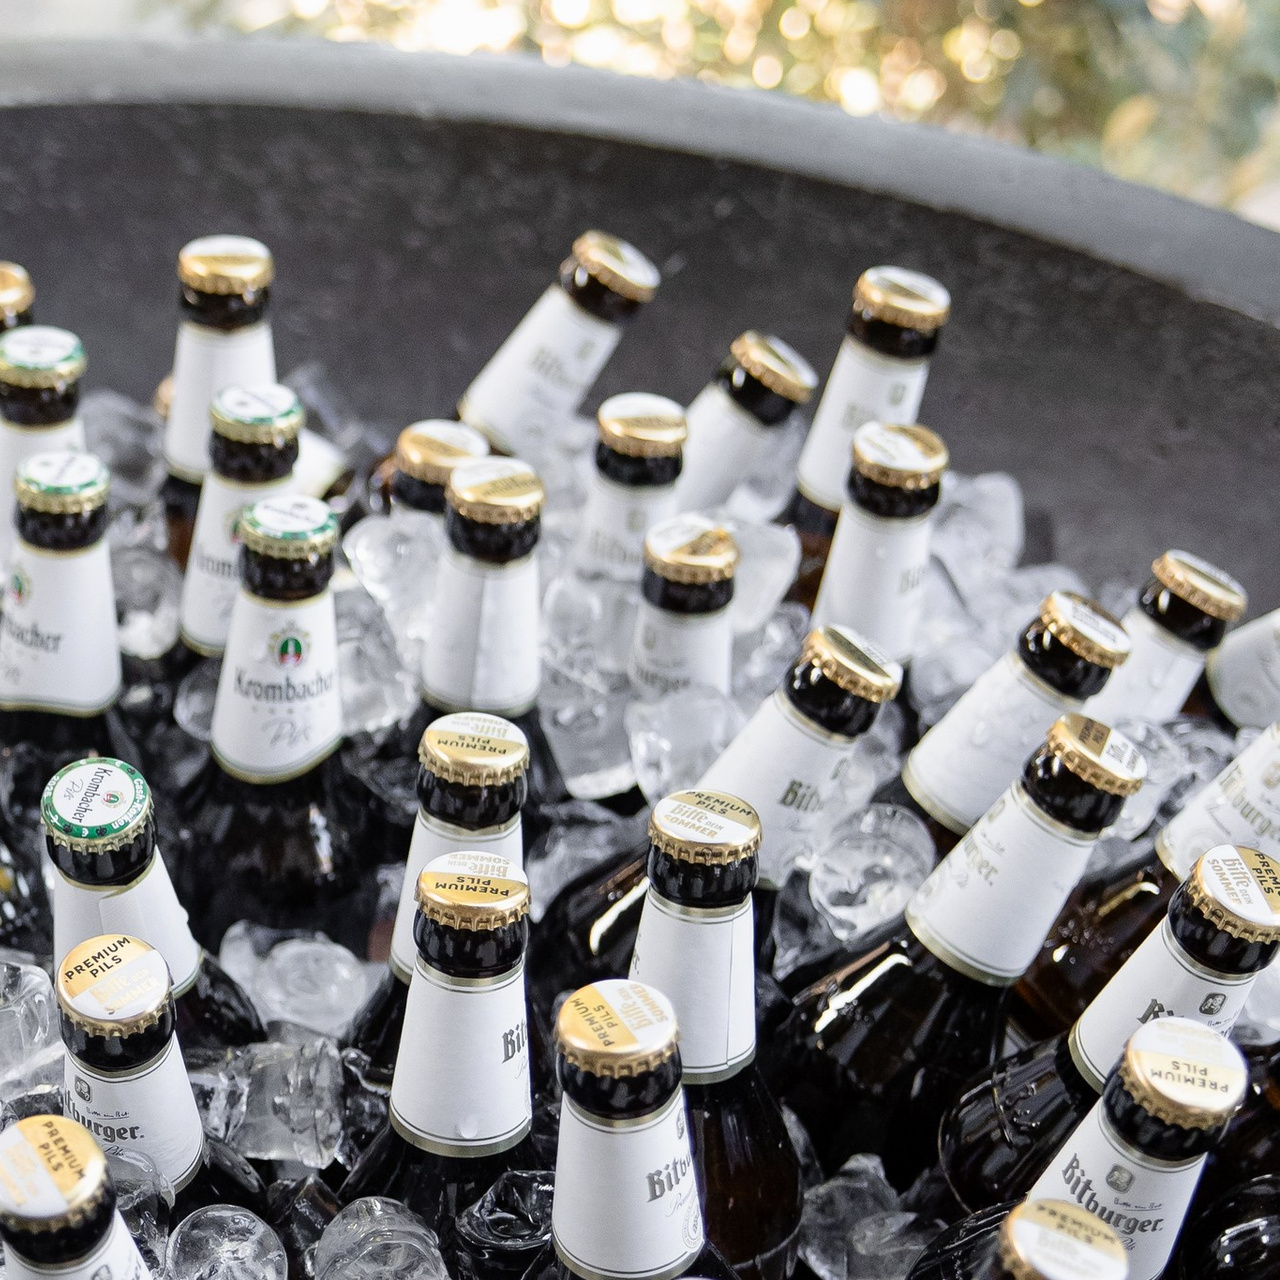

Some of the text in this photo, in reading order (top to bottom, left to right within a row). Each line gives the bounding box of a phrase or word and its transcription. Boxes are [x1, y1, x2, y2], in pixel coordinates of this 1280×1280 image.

[438, 738, 507, 755] PREMIUM
[458, 735, 491, 745] PILS
[63, 778, 84, 801] Pils
[71, 766, 114, 824] Krombacher
[110, 778, 146, 830] Cash-Korken
[686, 791, 752, 817] PREMIUM
[696, 800, 729, 816] PILS
[662, 814, 718, 839] SOMMER
[704, 820, 724, 831] DEIN
[434, 882, 510, 898] PREMIUM
[456, 876, 492, 887] PILS
[1207, 858, 1243, 906] SOMMER
[1252, 867, 1274, 896] PILS
[1239, 888, 1254, 906] DEIN
[65, 936, 131, 981] PREMIUM
[89, 954, 123, 979] PILS
[570, 997, 616, 1047] PREMIUM
[593, 1004, 619, 1029] PILS
[1151, 1068, 1229, 1093] PREMIUM
[1171, 1060, 1208, 1076] PILS
[38, 1141, 64, 1173] PILS
[41, 1120, 86, 1181] PREMIUM
